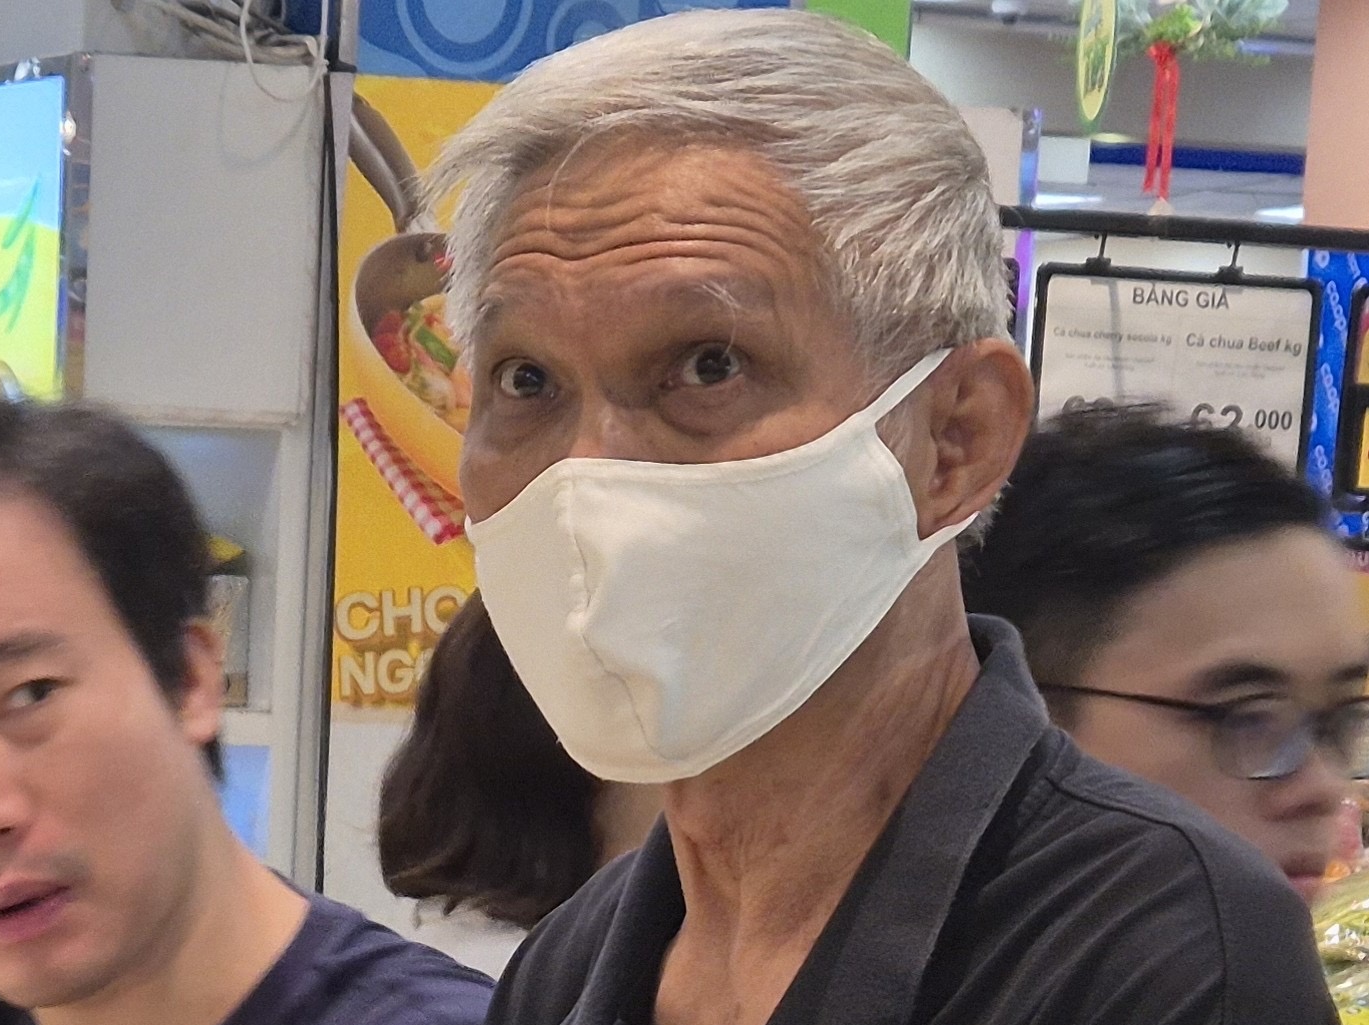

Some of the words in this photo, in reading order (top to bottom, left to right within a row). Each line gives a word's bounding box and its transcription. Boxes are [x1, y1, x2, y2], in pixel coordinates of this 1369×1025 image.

[1209, 334, 1244, 350] chua
[1248, 336, 1281, 352] Beef
[1284, 339, 1302, 357] kg
